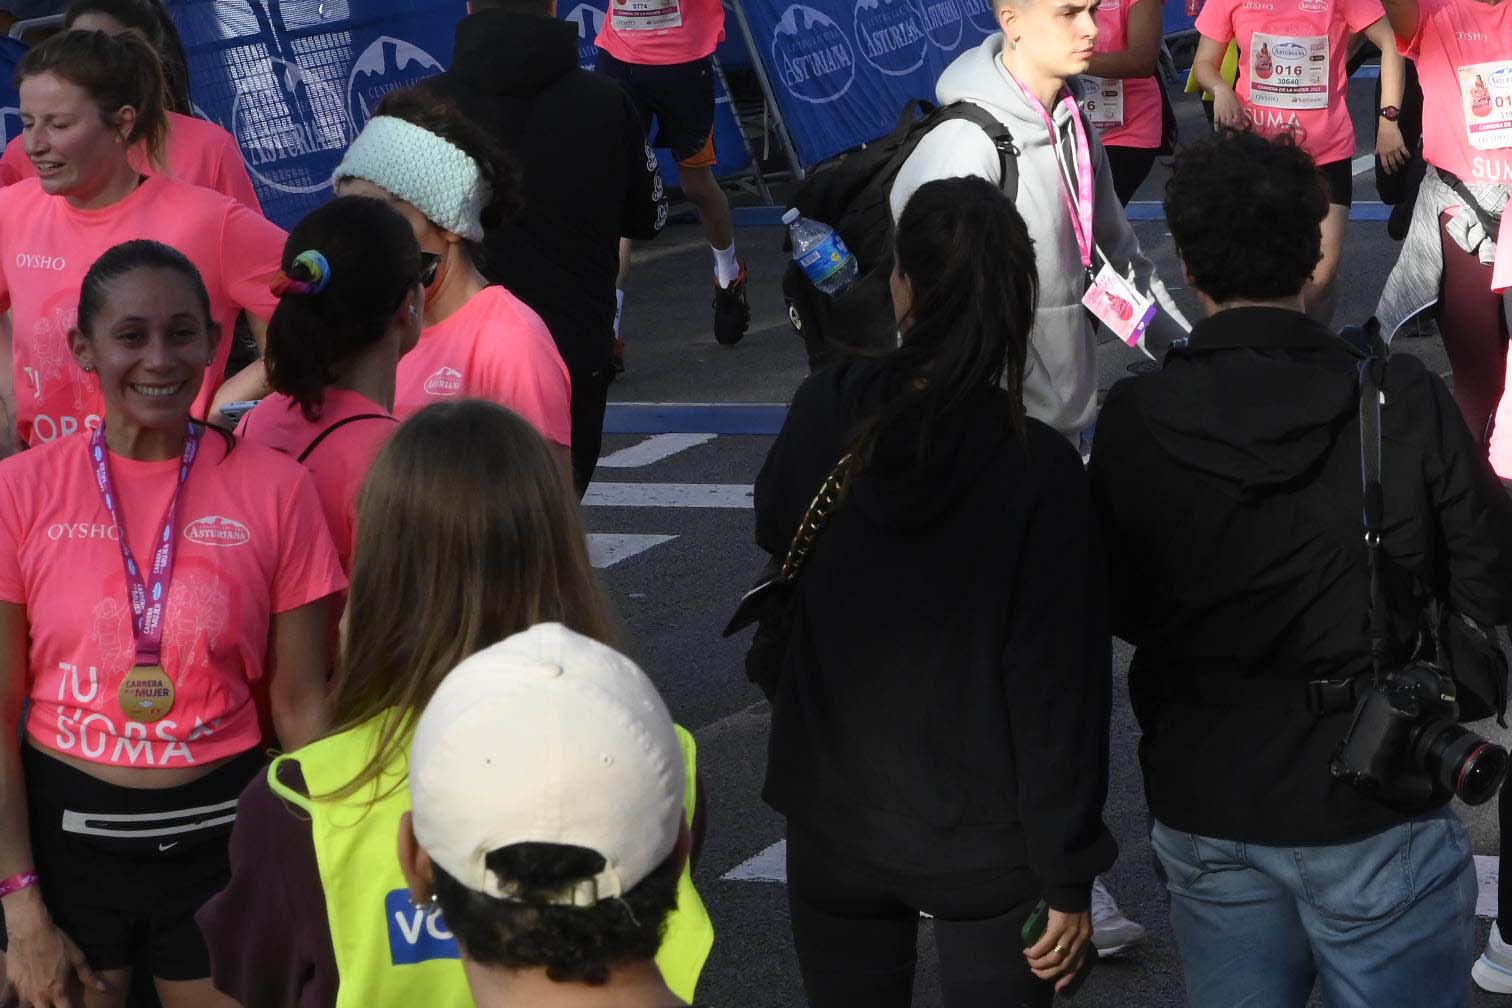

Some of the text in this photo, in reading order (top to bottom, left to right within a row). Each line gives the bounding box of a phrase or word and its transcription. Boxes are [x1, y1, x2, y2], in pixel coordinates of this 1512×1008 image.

[1275, 65, 1303, 76] 016
[1244, 107, 1300, 128] SUMA
[16, 253, 66, 271] OYSHO
[47, 523, 124, 541] OYSHO
[190, 527, 248, 542] ASTURIANA
[57, 662, 99, 703] TU
[126, 680, 163, 688] CARRERA
[135, 688, 169, 698] MUJER
[56, 715, 195, 766] SUMA
